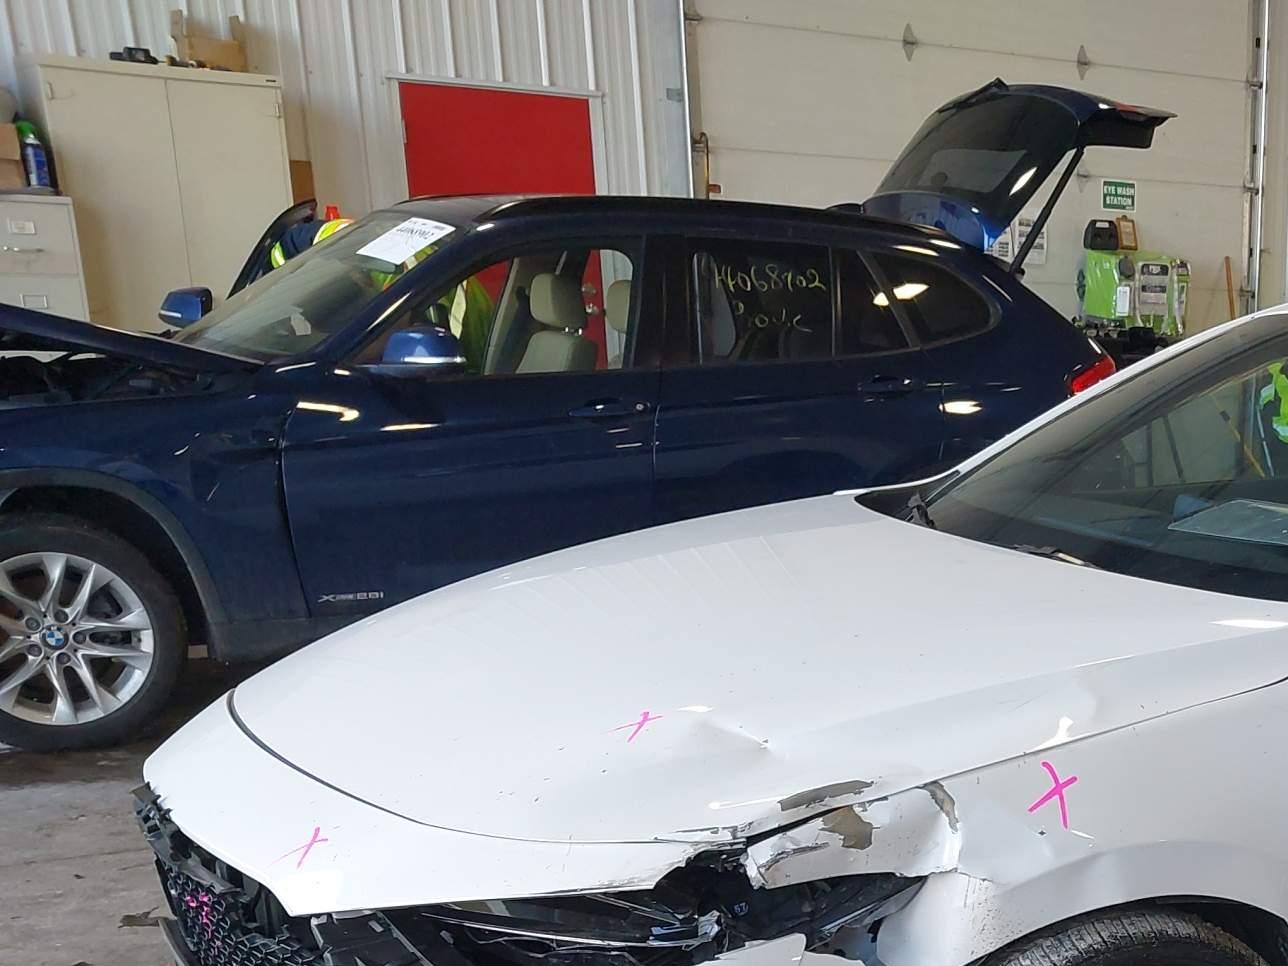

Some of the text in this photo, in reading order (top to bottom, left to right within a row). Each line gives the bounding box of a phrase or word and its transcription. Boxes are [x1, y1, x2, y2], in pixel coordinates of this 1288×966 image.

[1103, 185, 1135, 196] EYE WASH
[1105, 195, 1132, 206] STATION
